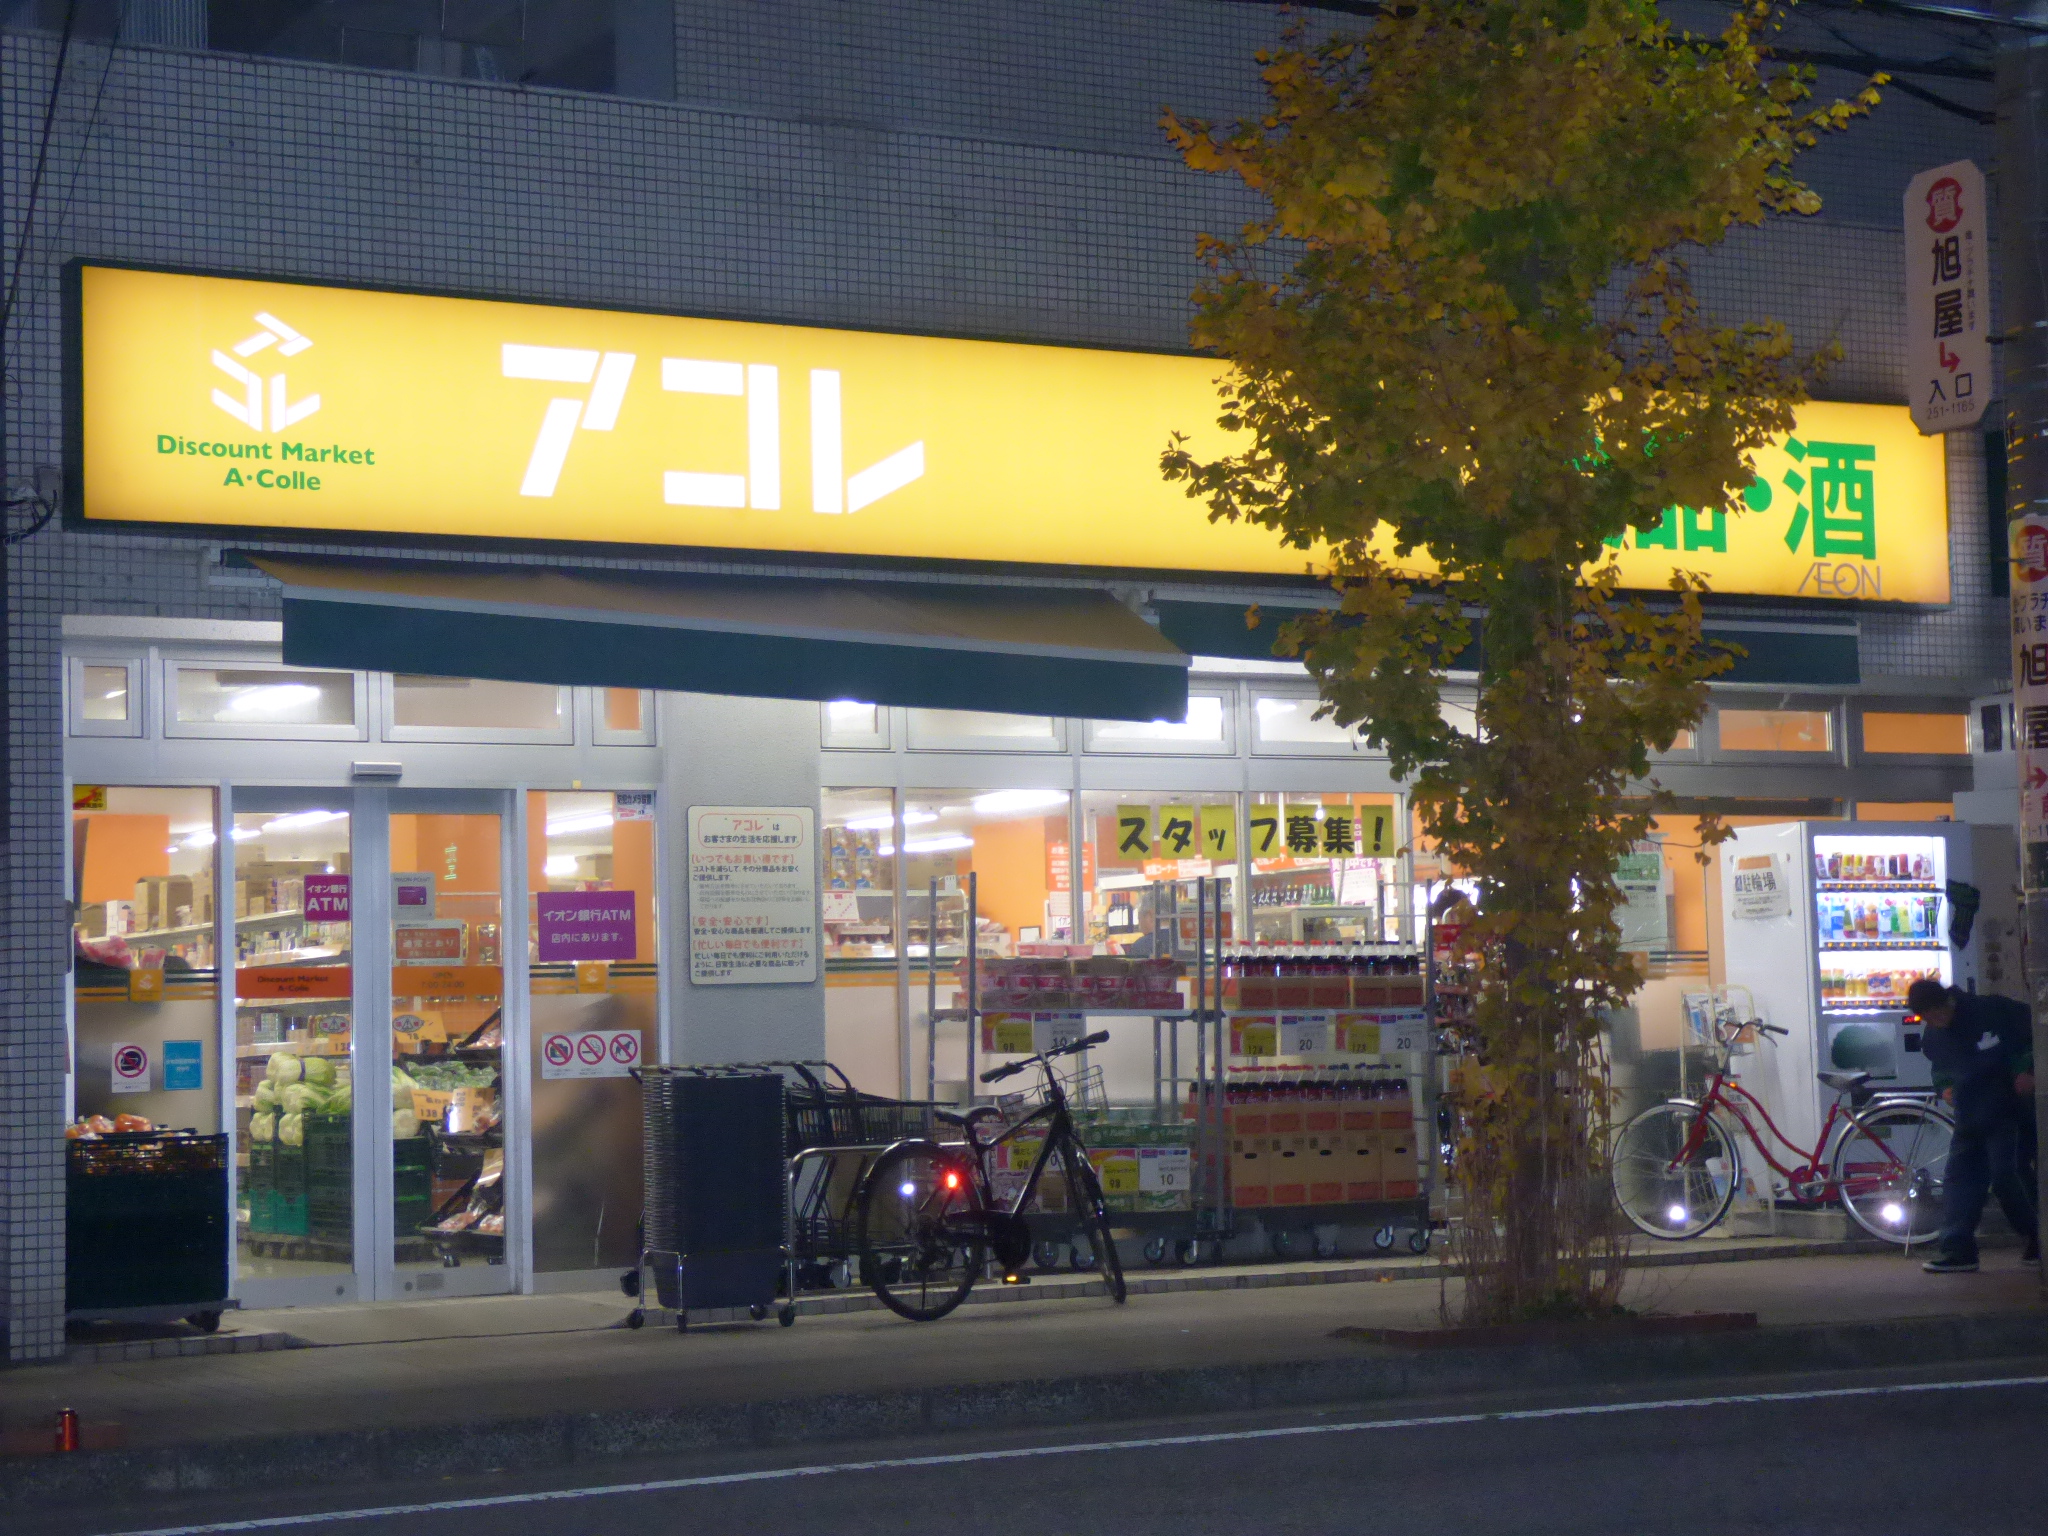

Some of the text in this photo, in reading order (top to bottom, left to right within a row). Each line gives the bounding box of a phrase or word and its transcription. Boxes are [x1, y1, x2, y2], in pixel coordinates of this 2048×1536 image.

[1931, 235, 1963, 339] 旭屋
[1929, 373, 1973, 404] 入口
[502, 343, 925, 515] アコレ
[157, 434, 376, 466] Discount Market
[732, 819, 764, 831] アコレ
[1743, 871, 1777, 892] 駐輪場
[306, 897, 348, 911] ATM
[543, 909, 631, 922] イオン銀行ATM
[1299, 1038, 1313, 1051] 20
[1397, 1037, 1411, 1050] 20
[1160, 1174, 1174, 1186] 10
